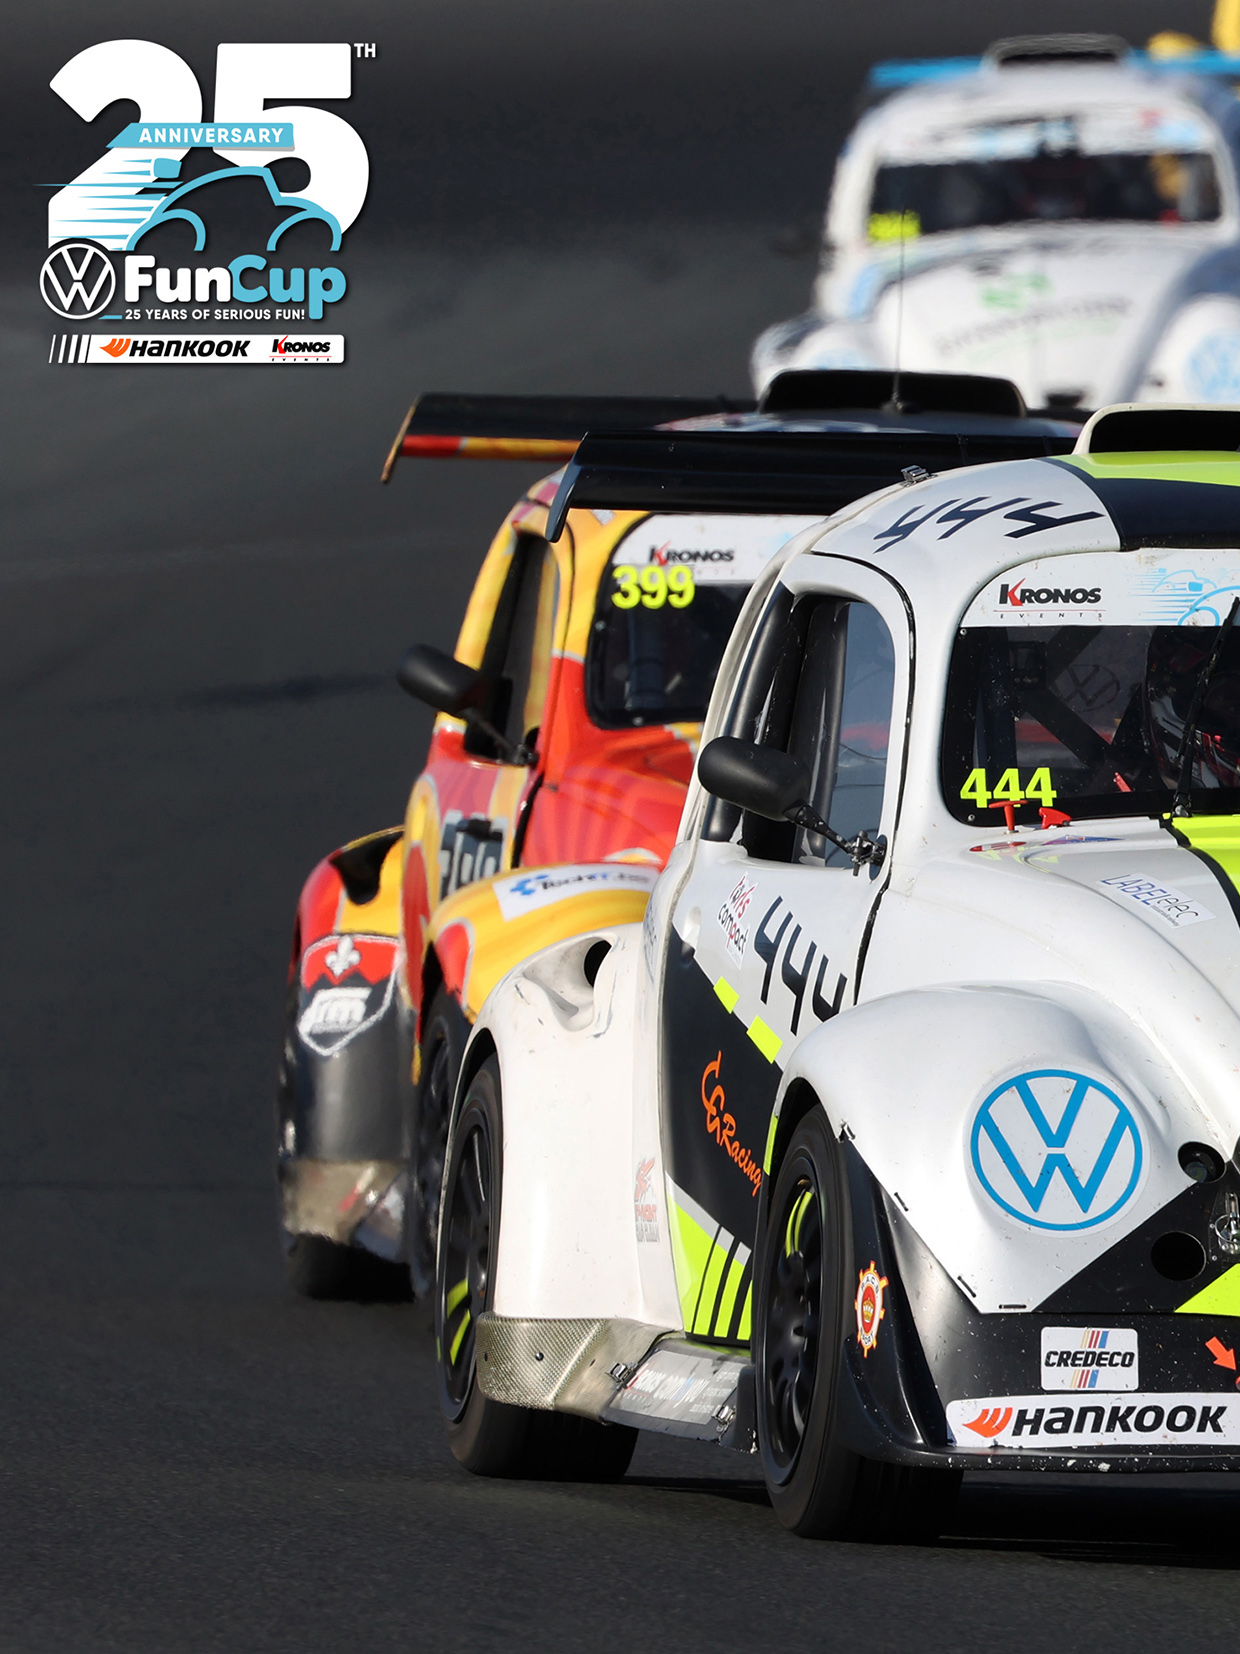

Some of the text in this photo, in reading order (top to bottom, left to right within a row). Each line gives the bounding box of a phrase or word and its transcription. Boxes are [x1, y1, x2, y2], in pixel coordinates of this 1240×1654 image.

[649, 540, 734, 566] KRONOS
[611, 565, 695, 610] 399
[999, 578, 1102, 606] KRONOS
[960, 767, 1057, 808] 444
[754, 895, 848, 1037] 444
[1045, 1350, 1135, 1368] CREDECO
